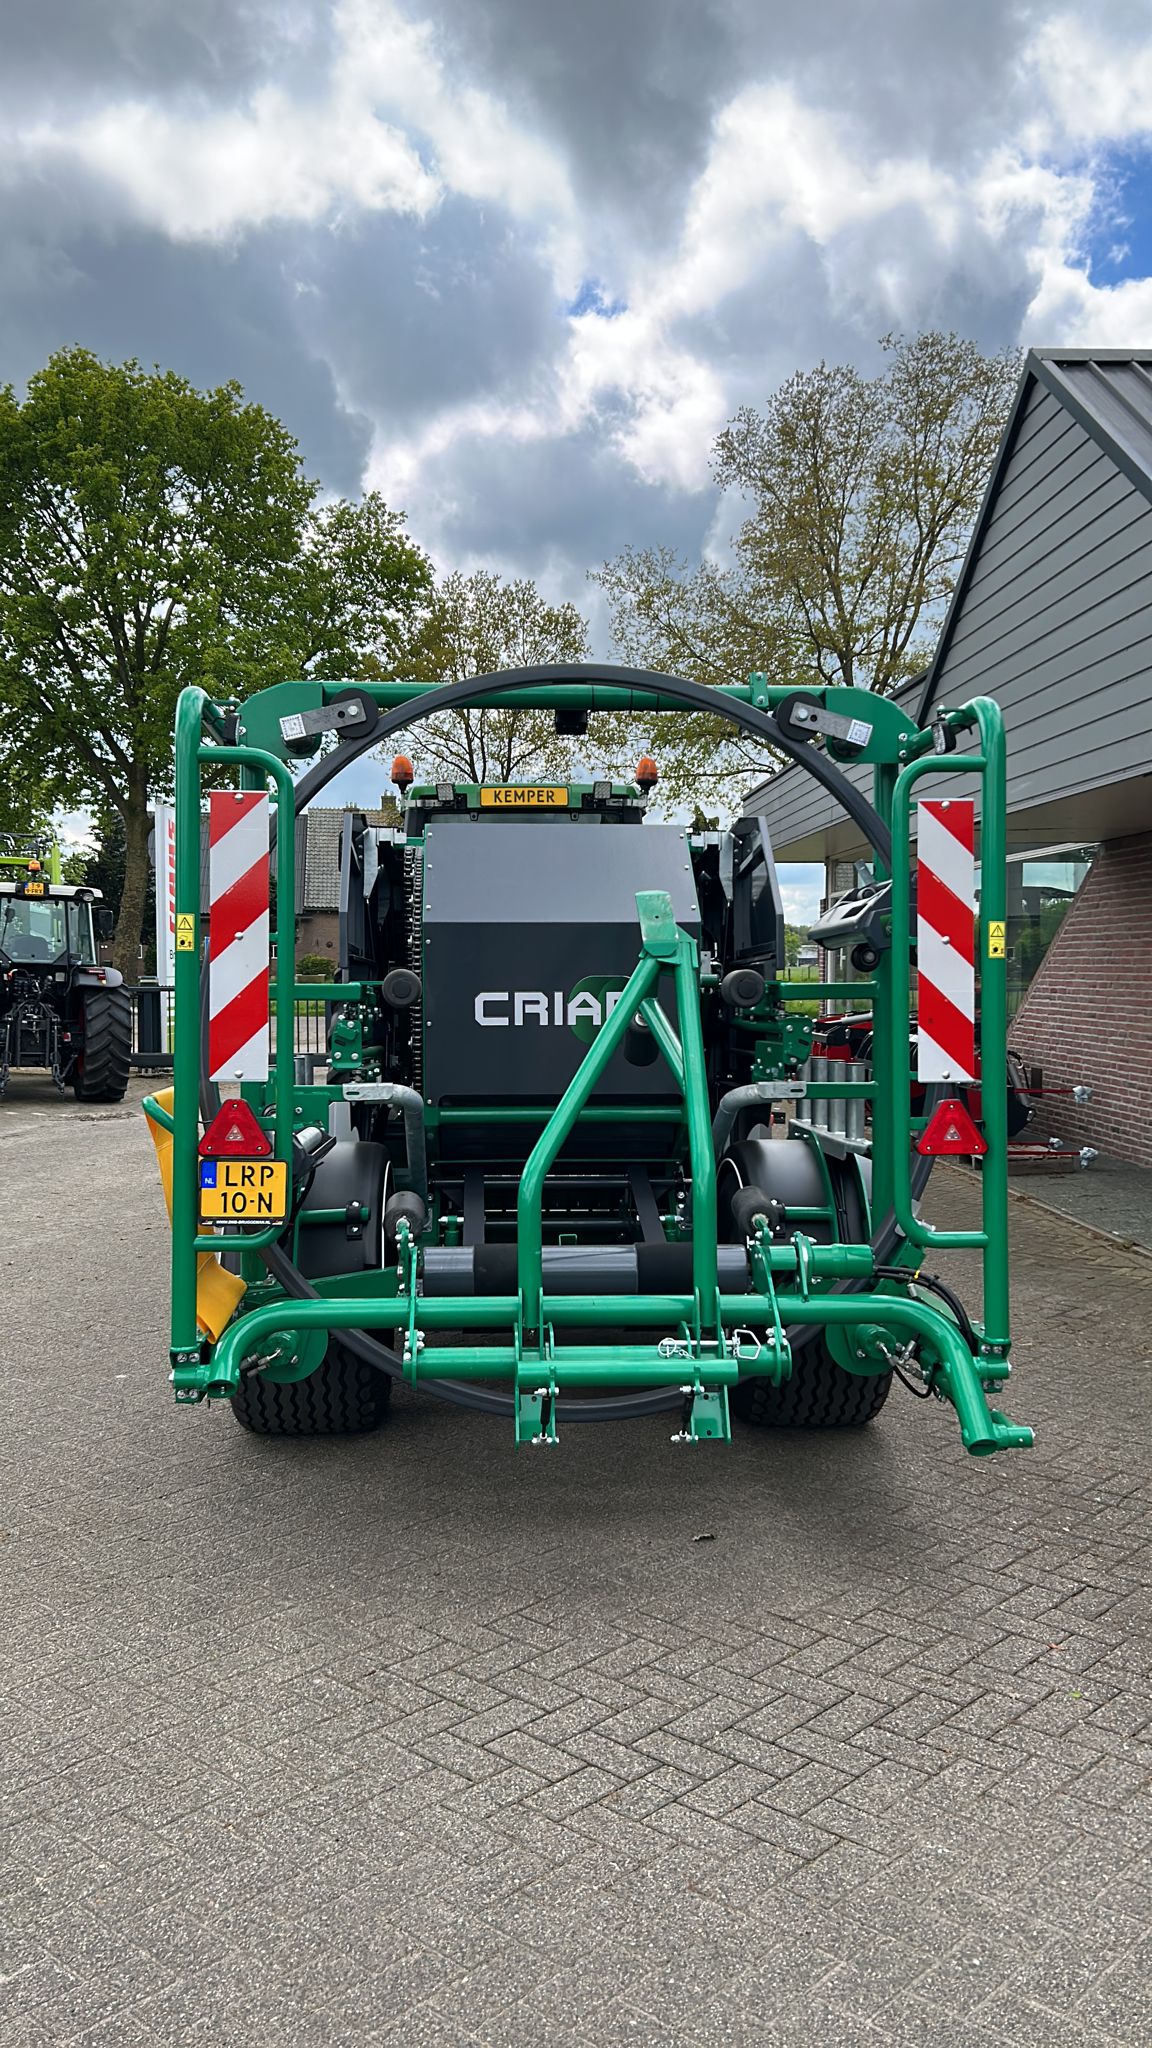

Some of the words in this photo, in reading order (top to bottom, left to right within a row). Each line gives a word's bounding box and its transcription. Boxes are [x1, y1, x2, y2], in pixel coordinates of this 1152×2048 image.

[494, 789, 555, 803] KEMPER
[204, 1177, 215, 1185] NL
[225, 1165, 274, 1187] LRP
[220, 1191, 272, 1213] 10-N
